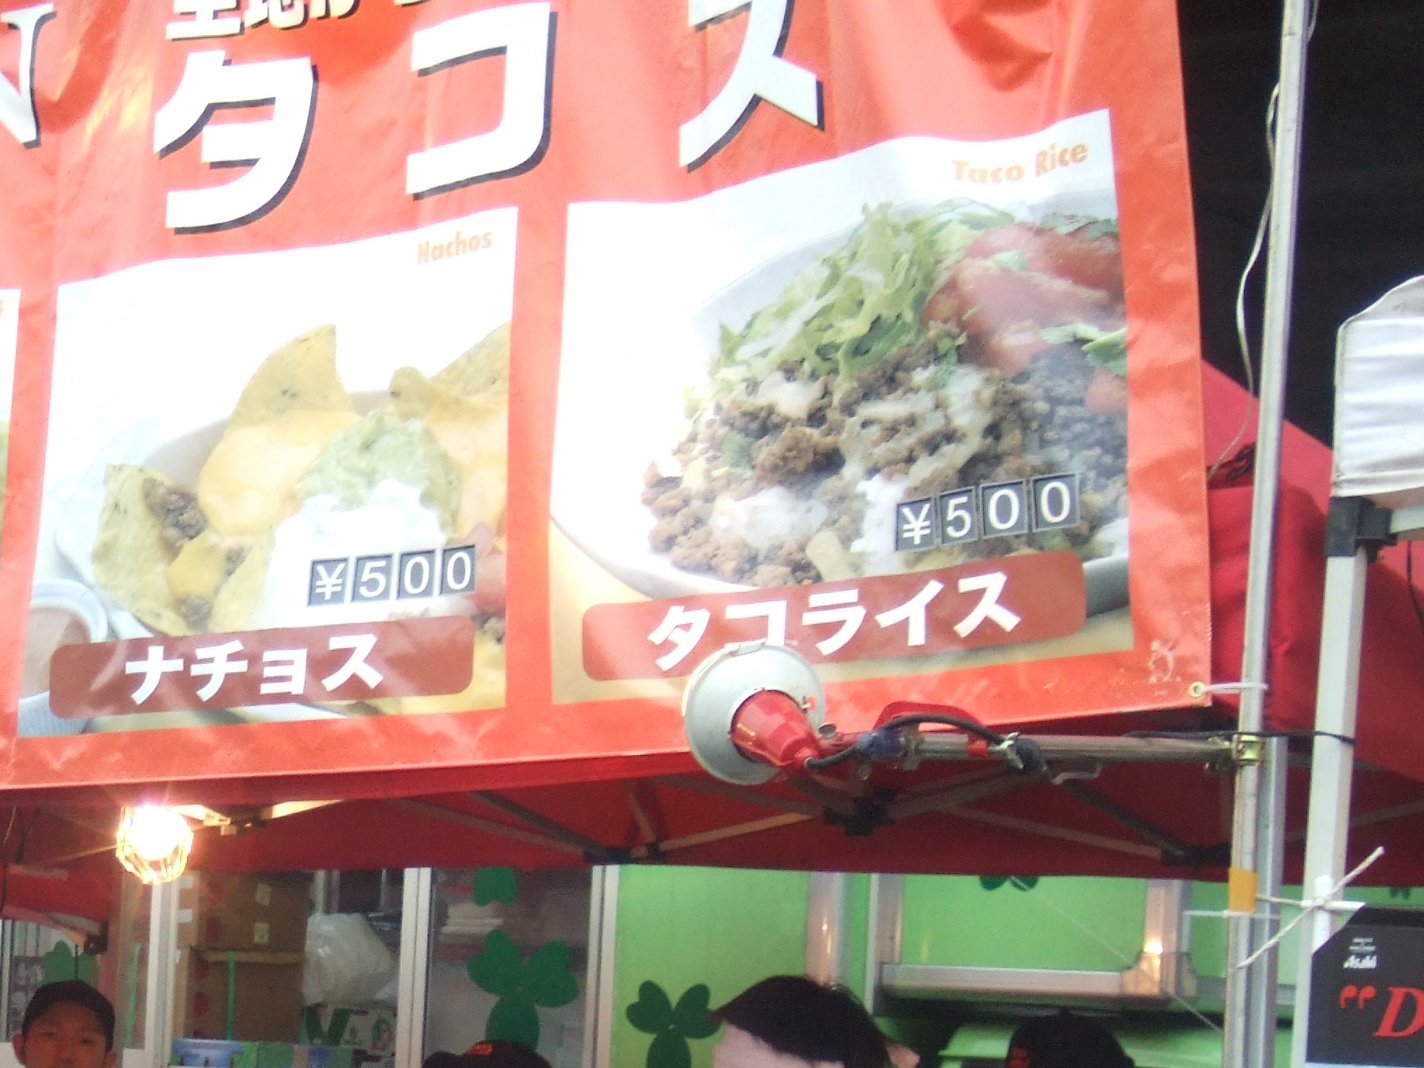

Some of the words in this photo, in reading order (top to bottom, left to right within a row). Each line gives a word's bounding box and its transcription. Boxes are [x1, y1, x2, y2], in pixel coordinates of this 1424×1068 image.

[153, 0, 823, 234] タコス
[951, 157, 1025, 185] Taco
[1034, 140, 1089, 178] Rice
[416, 228, 494, 265] Nachos
[900, 481, 1073, 546] ¥500
[312, 550, 473, 601] ¥500
[647, 570, 1022, 671] タコライス
[124, 633, 385, 706] ナチョス
